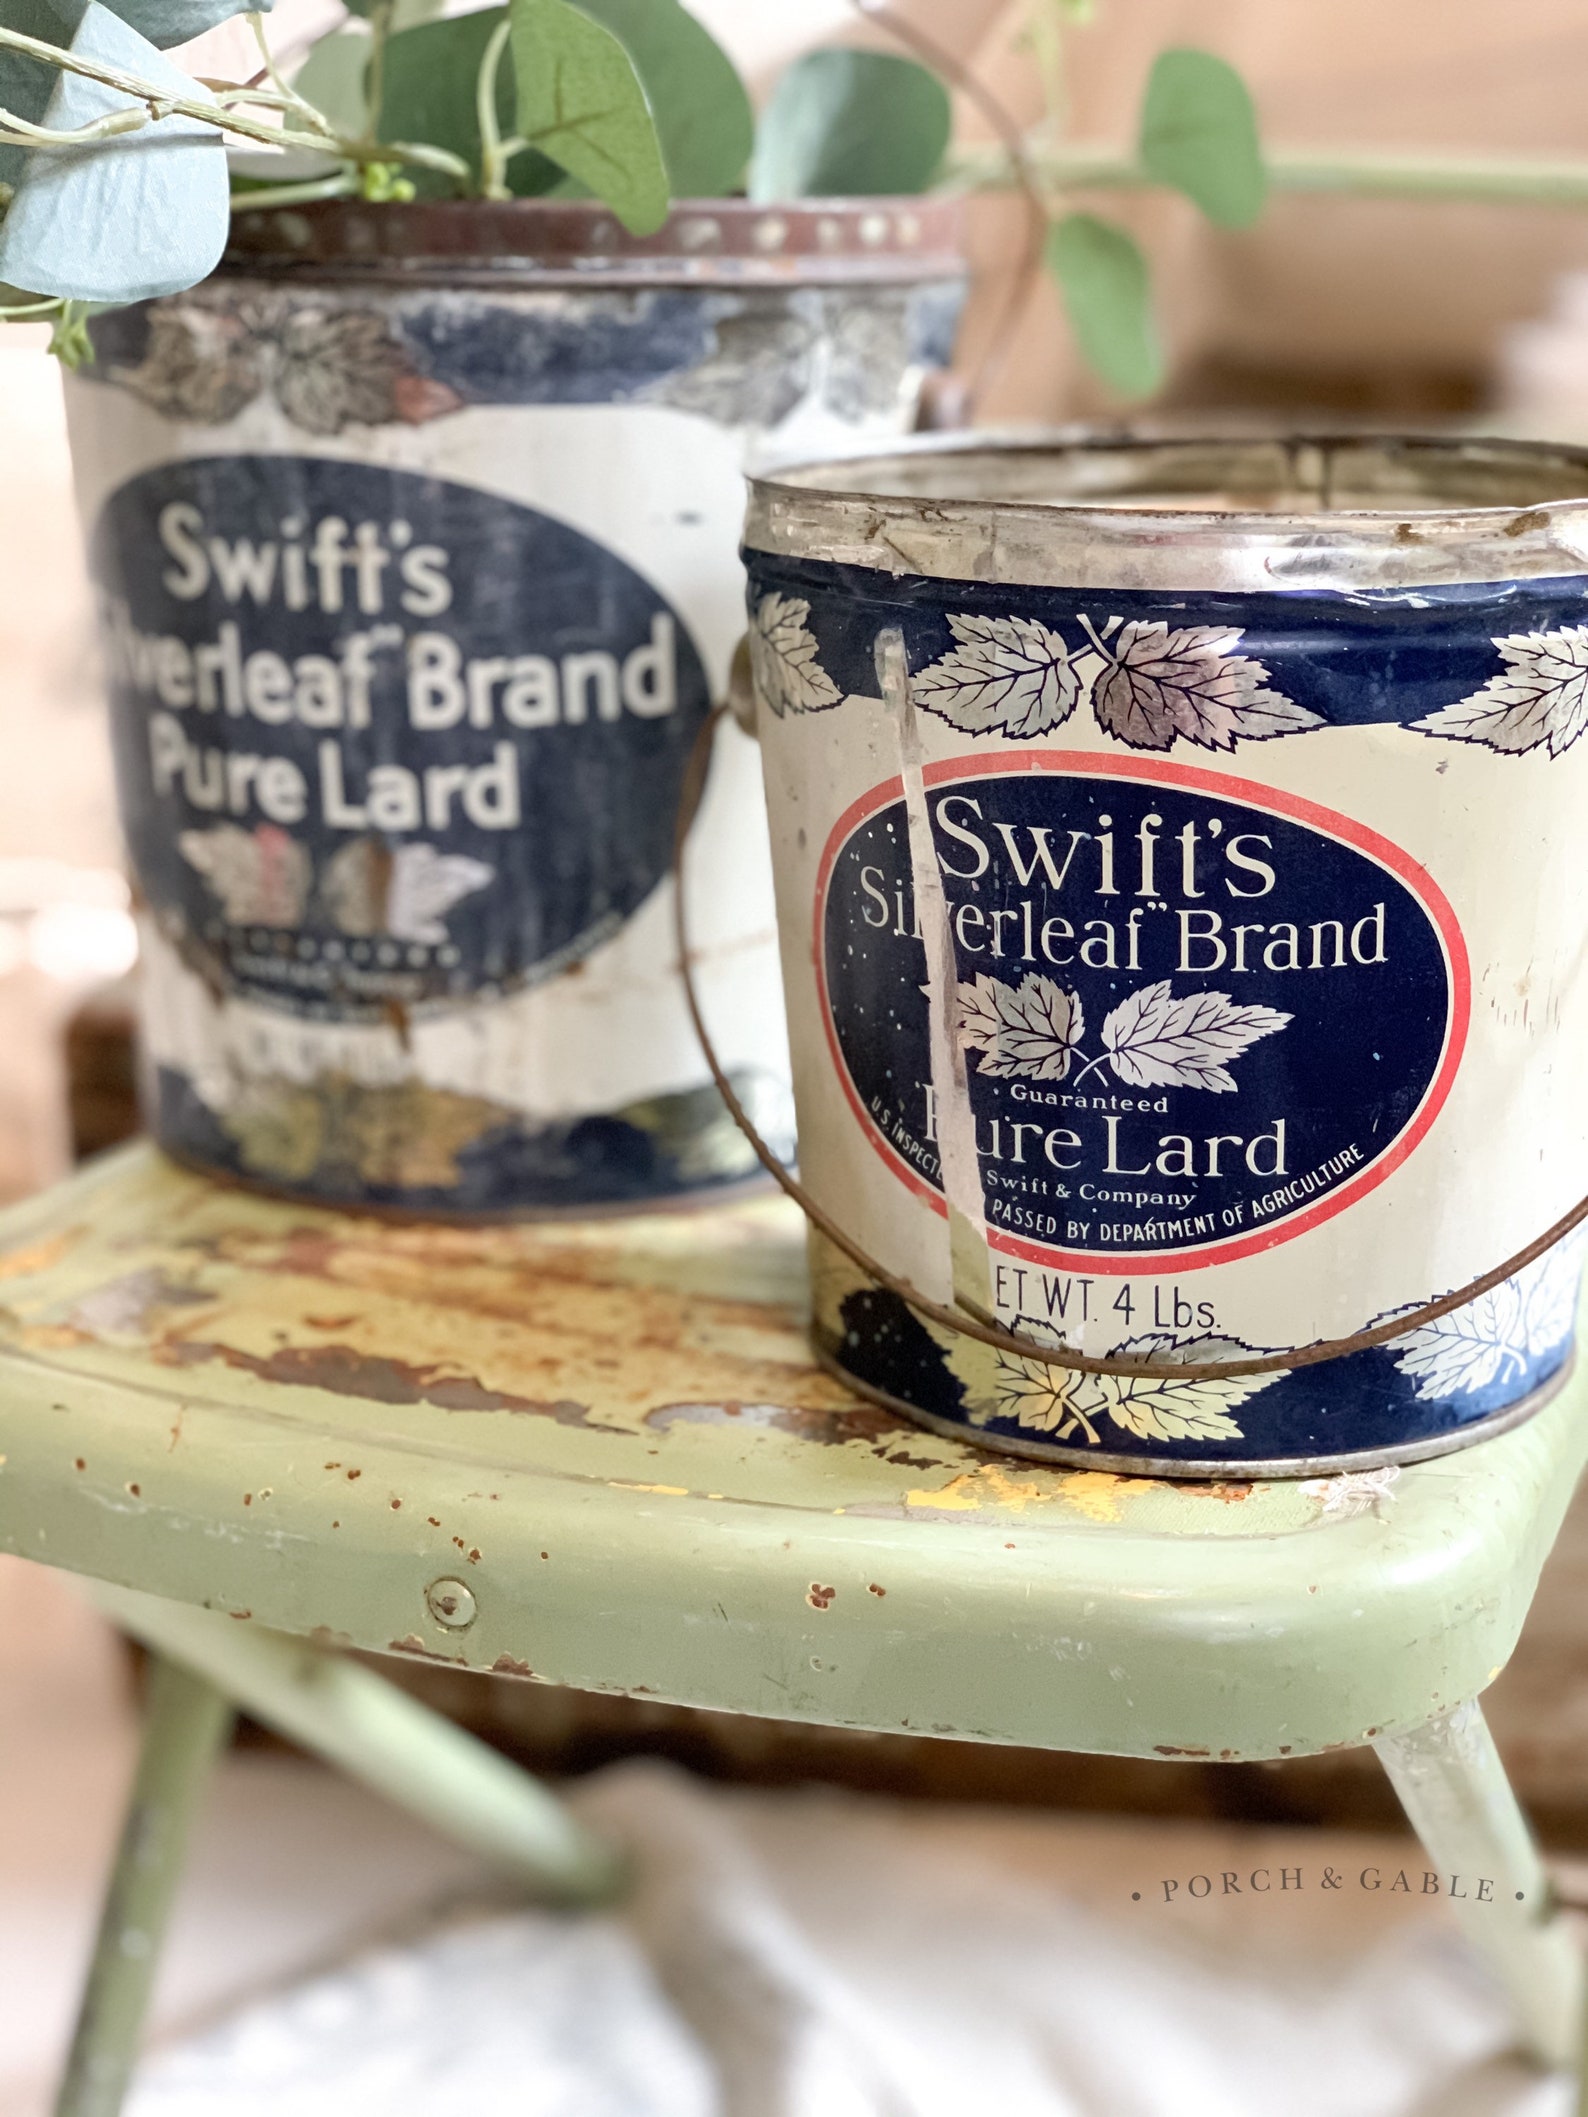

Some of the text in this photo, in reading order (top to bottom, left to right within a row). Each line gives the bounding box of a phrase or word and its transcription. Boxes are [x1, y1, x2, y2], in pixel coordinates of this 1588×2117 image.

[159, 502, 454, 617] Swift's
[406, 611, 678, 731] Brand
[149, 710, 522, 830] Pure Lard
[936, 795, 1276, 898] Swift’s
[1174, 902, 1389, 972] Brand
[1010, 1083, 1168, 1113] Guaranteed
[1101, 1115, 1290, 1177] Lard
[986, 1169, 1198, 1211] Swift & Company
[992, 1198, 1057, 1235] PASSED
[1067, 1220, 1091, 1240] BY
[1100, 1212, 1216, 1242] DEPARTMENT
[1222, 1205, 1245, 1227] OF
[1251, 1143, 1365, 1219] AGRICULTURE
[996, 1265, 1222, 1329] ET WT. 4 Lbs.
